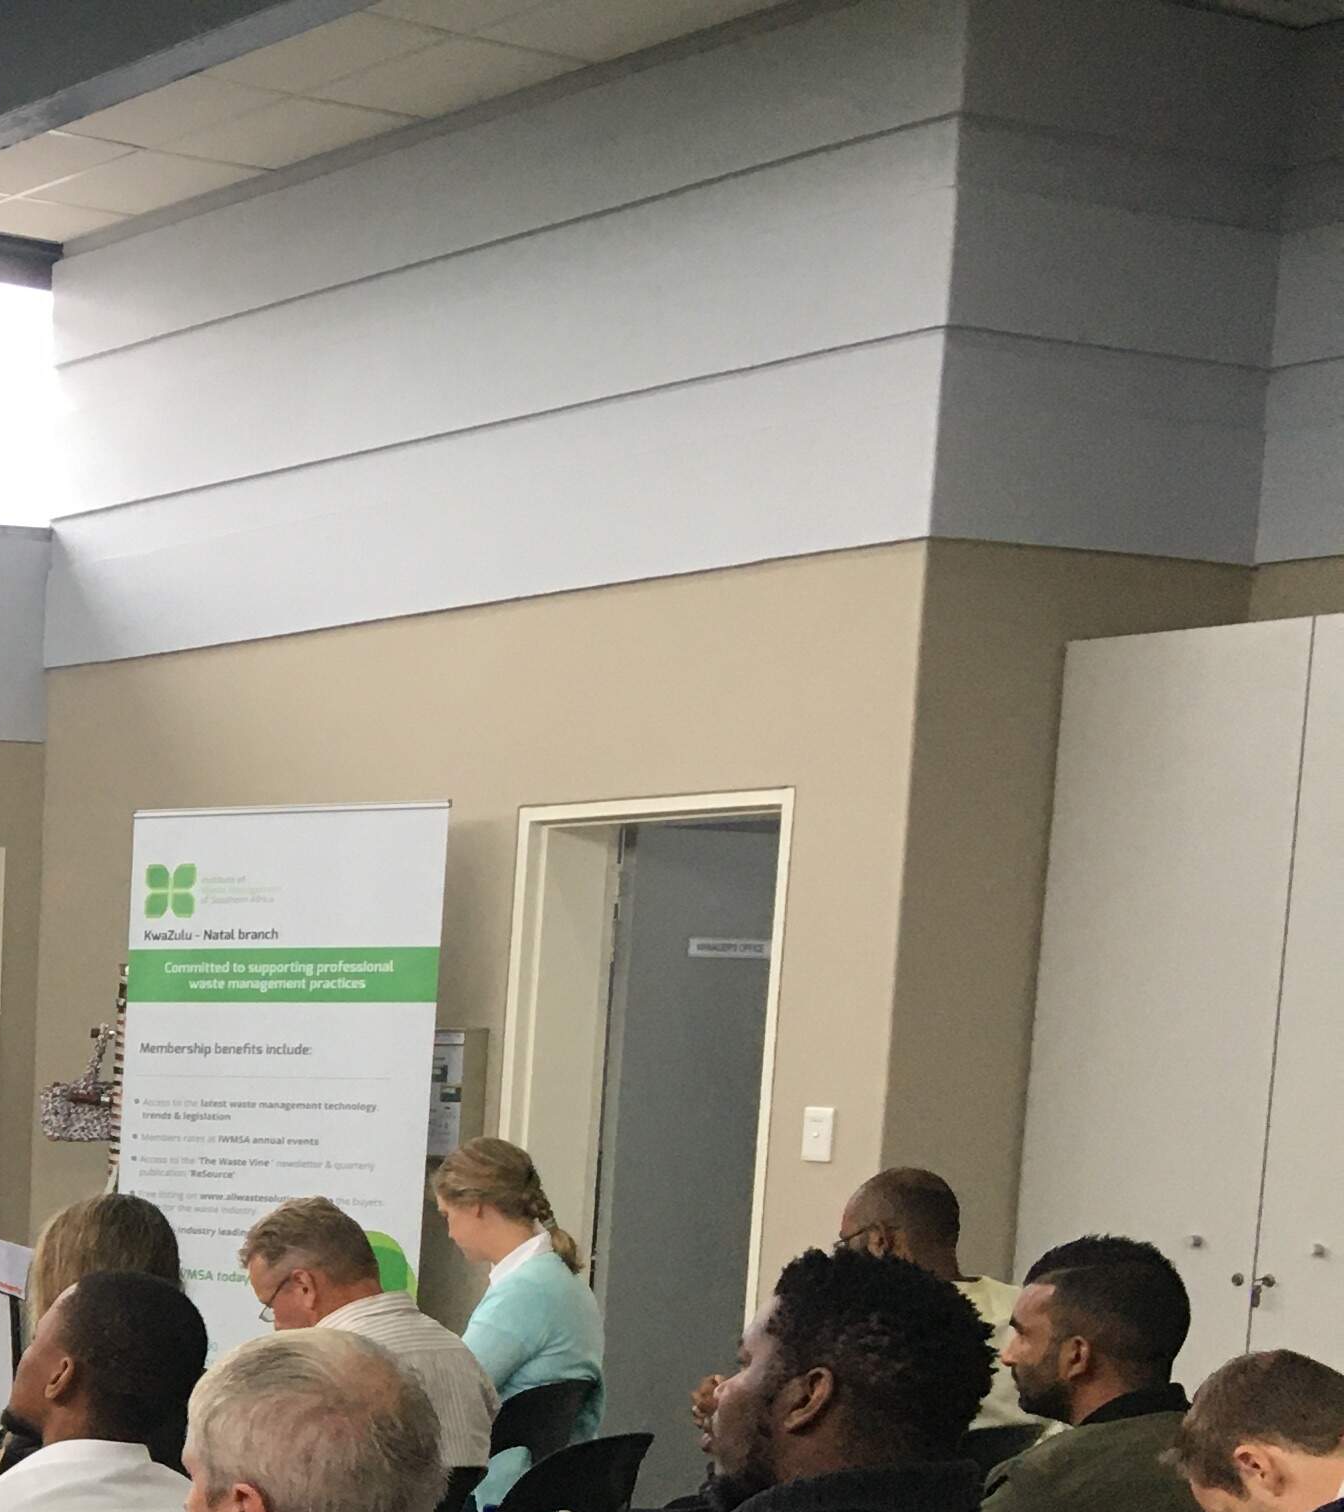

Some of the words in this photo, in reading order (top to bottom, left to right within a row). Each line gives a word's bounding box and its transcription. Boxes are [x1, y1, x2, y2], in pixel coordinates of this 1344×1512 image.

[144, 930, 191, 942] KwaZulu
[204, 929, 235, 940] Natal
[238, 928, 278, 940] branch
[164, 961, 229, 973] Committed
[233, 962, 245, 973] to
[249, 961, 313, 976] supporting
[317, 960, 394, 975] professional
[189, 979, 225, 989] waste
[228, 979, 306, 992] management
[310, 978, 365, 992] practices
[139, 1042, 211, 1057] Membership
[214, 1042, 262, 1055] benefits
[265, 1043, 312, 1056] include:
[200, 1100, 226, 1109] latest
[229, 1101, 256, 1109] waste
[259, 1100, 321, 1112] management
[142, 1111, 171, 1121] trends
[174, 1112, 181, 1121] &
[183, 1111, 231, 1123] legislation
[218, 1135, 250, 1144] IWMSA
[252, 1135, 284, 1145] annual
[287, 1136, 319, 1146] events
[218, 1157, 247, 1167] Waste
